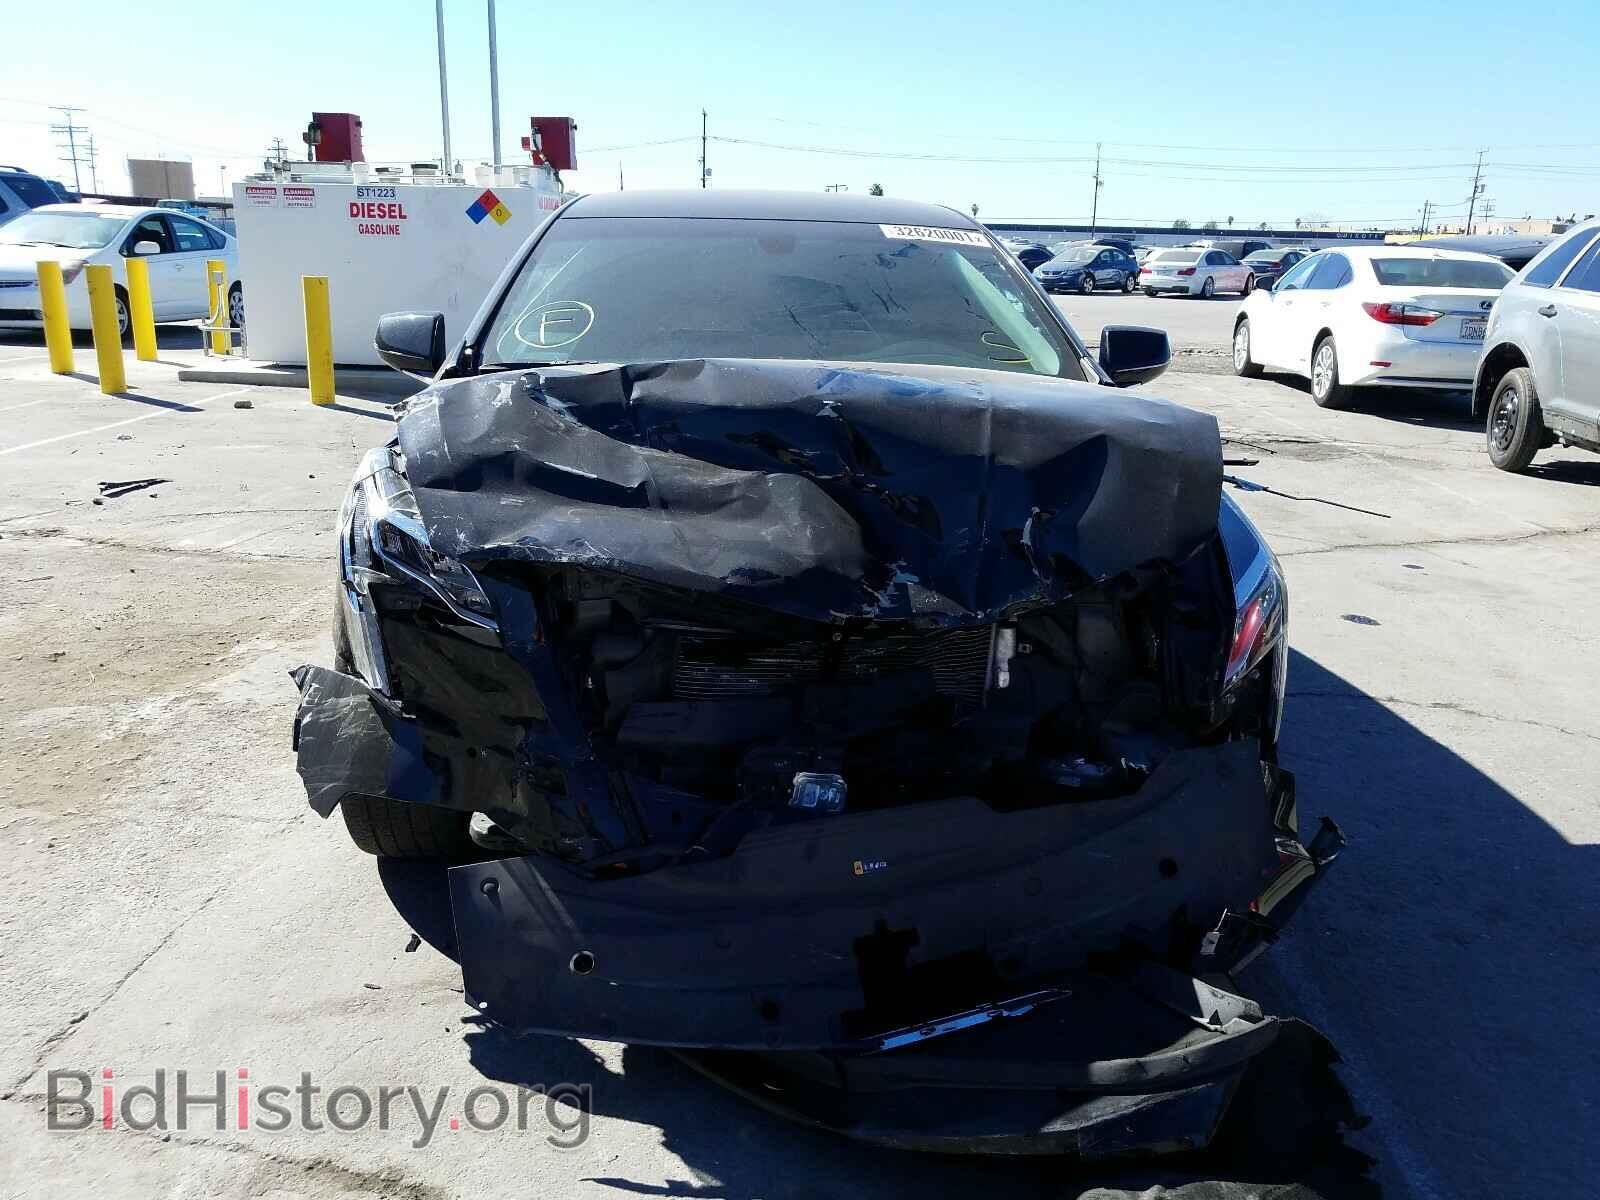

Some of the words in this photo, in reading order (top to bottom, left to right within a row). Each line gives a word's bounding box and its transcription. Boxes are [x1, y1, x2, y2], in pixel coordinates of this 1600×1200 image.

[357, 188, 396, 198] ST1223
[349, 202, 408, 220] DIESEL
[358, 223, 401, 236] GASOLINE
[540, 308, 583, 345] F
